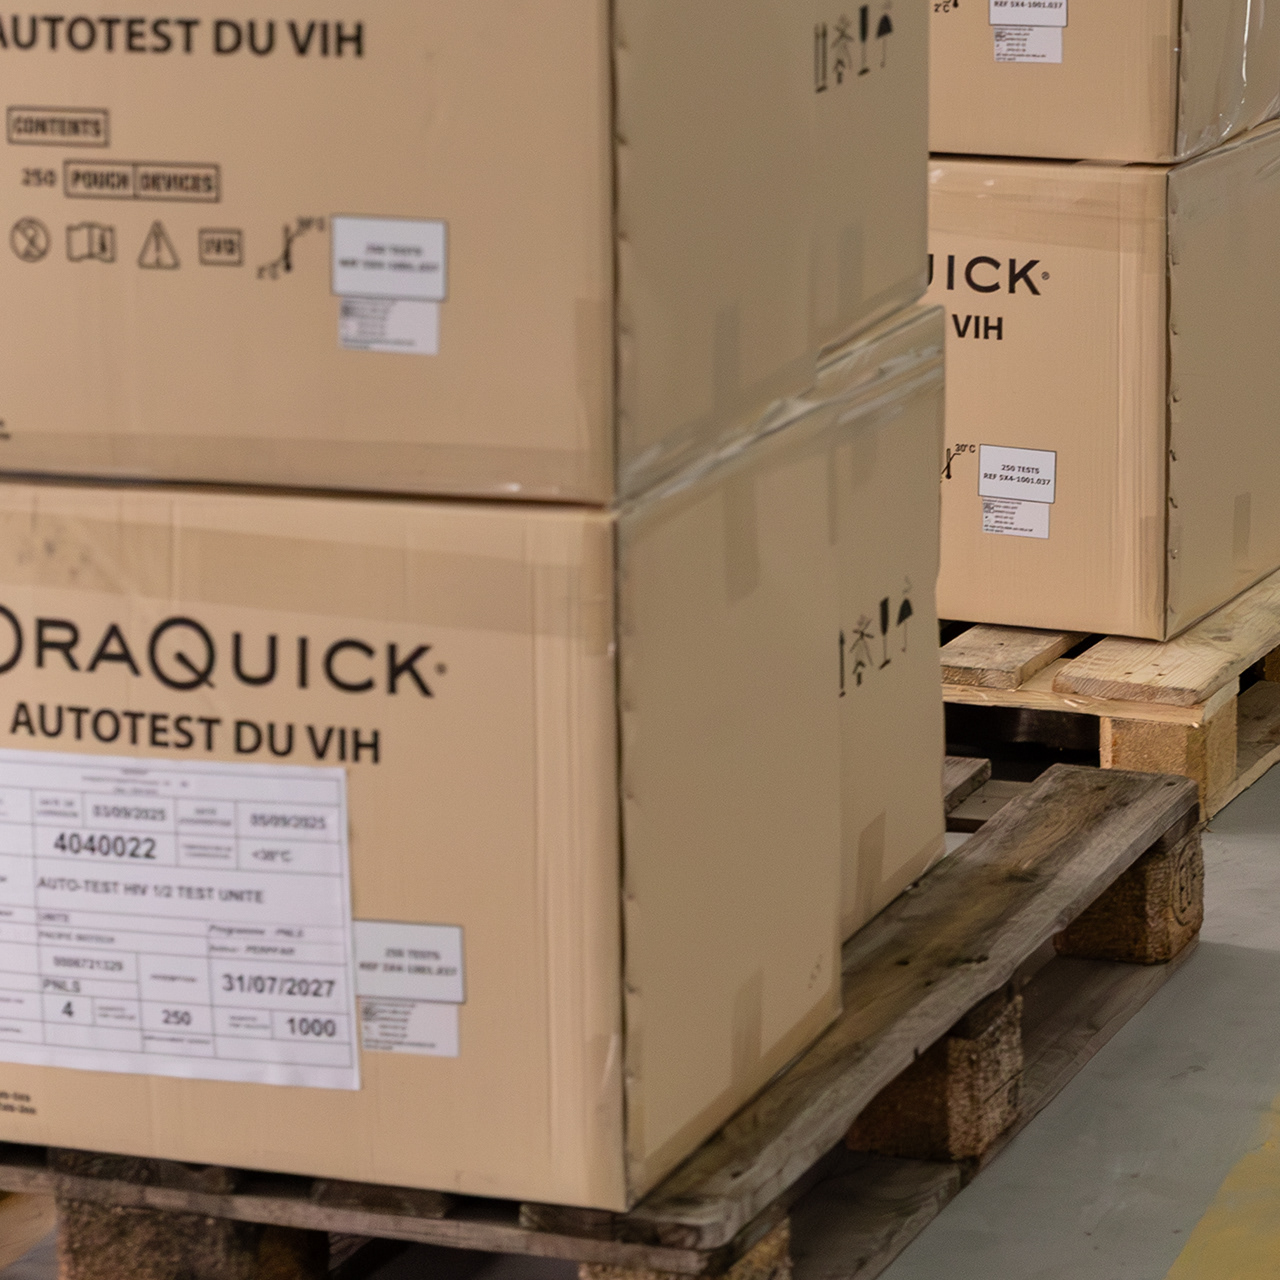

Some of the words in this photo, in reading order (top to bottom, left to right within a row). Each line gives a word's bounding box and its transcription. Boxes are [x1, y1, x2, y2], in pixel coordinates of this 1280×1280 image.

[214, 19, 277, 56] DU
[288, 21, 365, 58] VIH
[13, 116, 102, 137] CONTENTS
[22, 168, 57, 188] 250
[72, 169, 130, 191] POUCH
[140, 172, 214, 194] DEVICES
[927, 253, 1042, 296] ICK
[951, 313, 1004, 340] VIH
[983, 472, 997, 480] REF
[1001, 464, 1016, 473] 250
[1017, 465, 1040, 475] TESTS
[10, 701, 221, 753] AUTOTEST
[234, 721, 294, 759] DU
[308, 726, 381, 765] VIH
[53, 831, 157, 860] 4040022
[36, 877, 119, 895] AUTO-TEST
[123, 883, 147, 897] HIV
[154, 885, 172, 898] 1/2
[177, 885, 215, 901] TEST
[219, 889, 265, 904] UNITE
[42, 978, 81, 993] PNLS
[221, 972, 337, 999] 31/07/2027
[61, 1001, 74, 1018] 4
[161, 1008, 193, 1027] 250
[286, 1016, 337, 1038] 1000
